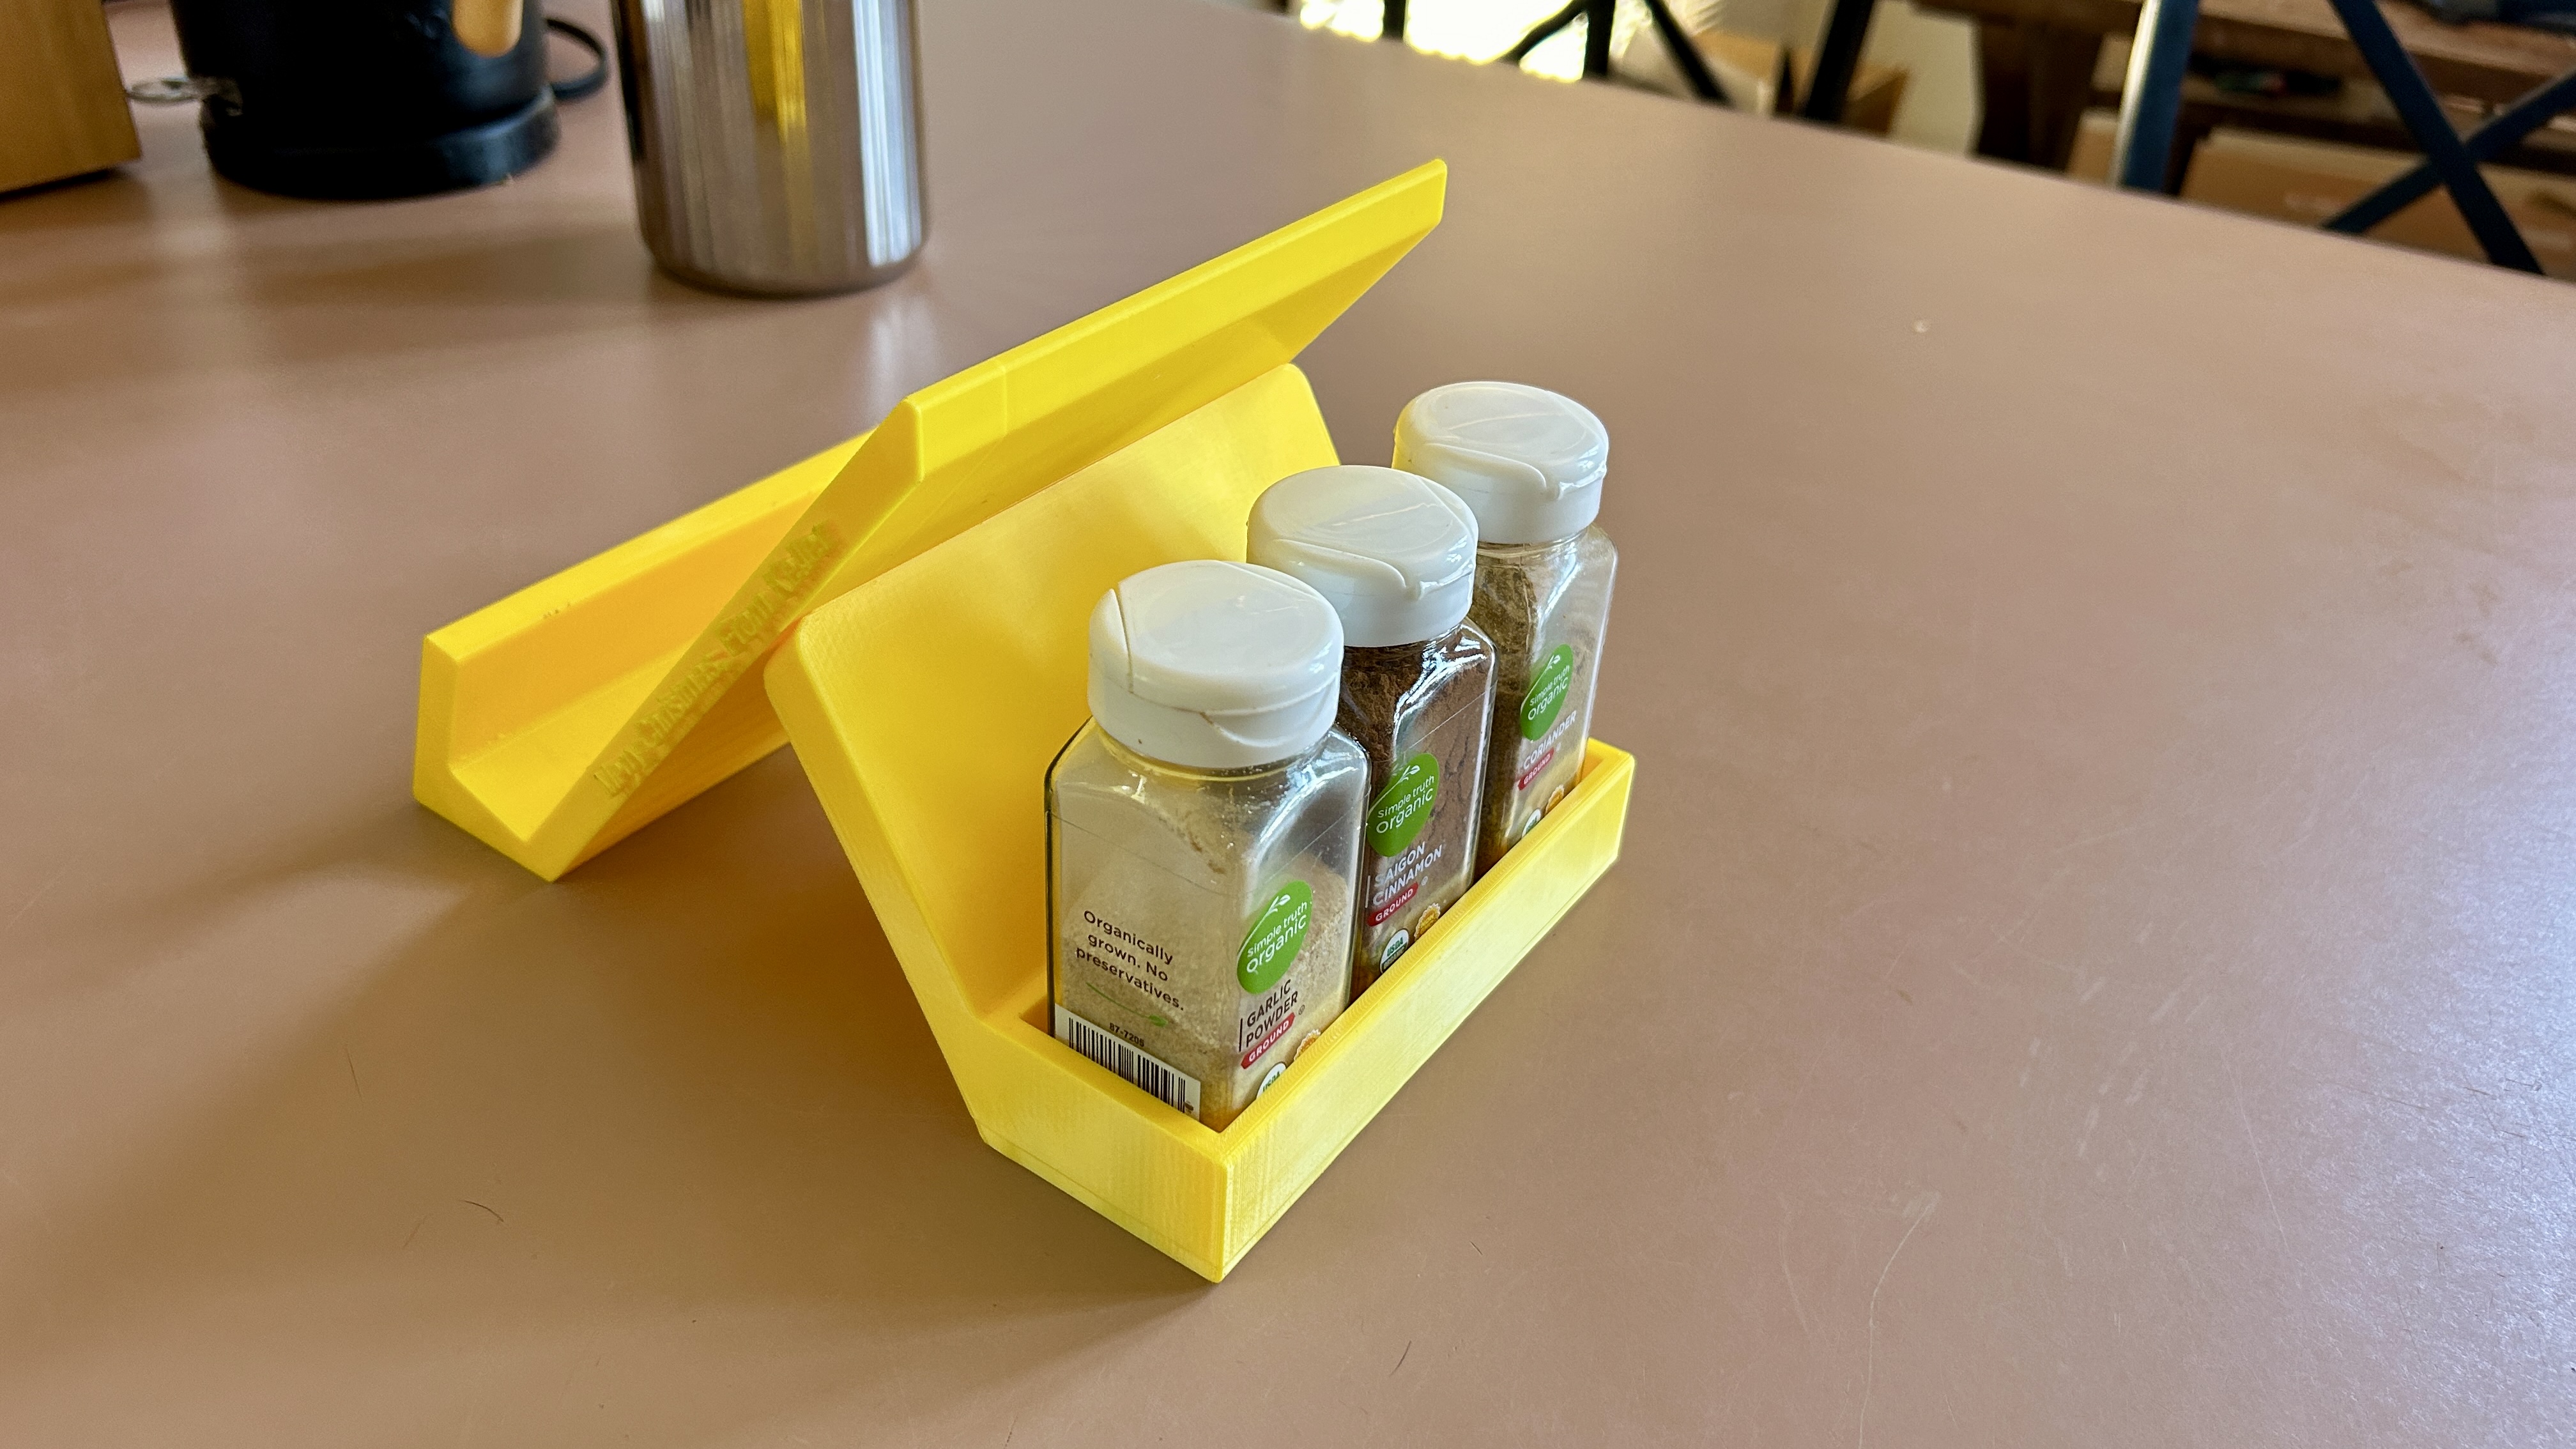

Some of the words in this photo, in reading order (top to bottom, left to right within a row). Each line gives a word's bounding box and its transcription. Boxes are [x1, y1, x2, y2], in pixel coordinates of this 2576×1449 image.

[1528, 677, 1568, 721] organic
[1529, 681, 1553, 706] simple
[1553, 664, 1570, 685] truth
[1523, 710, 1577, 770] CORIANDER
[1523, 755, 1551, 785] GROUND
[1376, 787, 1433, 834] organic
[1377, 793, 1411, 818] simple
[1412, 775, 1434, 796] truth
[1373, 845, 1443, 907] CINNAMON
[1374, 841, 1426, 887] SAIGON
[1247, 924, 1282, 958] simple
[1282, 901, 1308, 928] truth
[1375, 889, 1413, 923] GROUND
[1084, 910, 1174, 965] Organically
[1087, 932, 1141, 969] grown.
[1146, 961, 1169, 982] No
[1246, 914, 1307, 974] organic
[1387, 937, 1404, 957] USDA
[1076, 947, 1184, 1011] preservatives.
[1245, 991, 1298, 1048] POWDER
[1246, 979, 1292, 1027] GARLIC
[1109, 1023, 1145, 1048] 87-7205
[1248, 1020, 1289, 1063] GROUND
